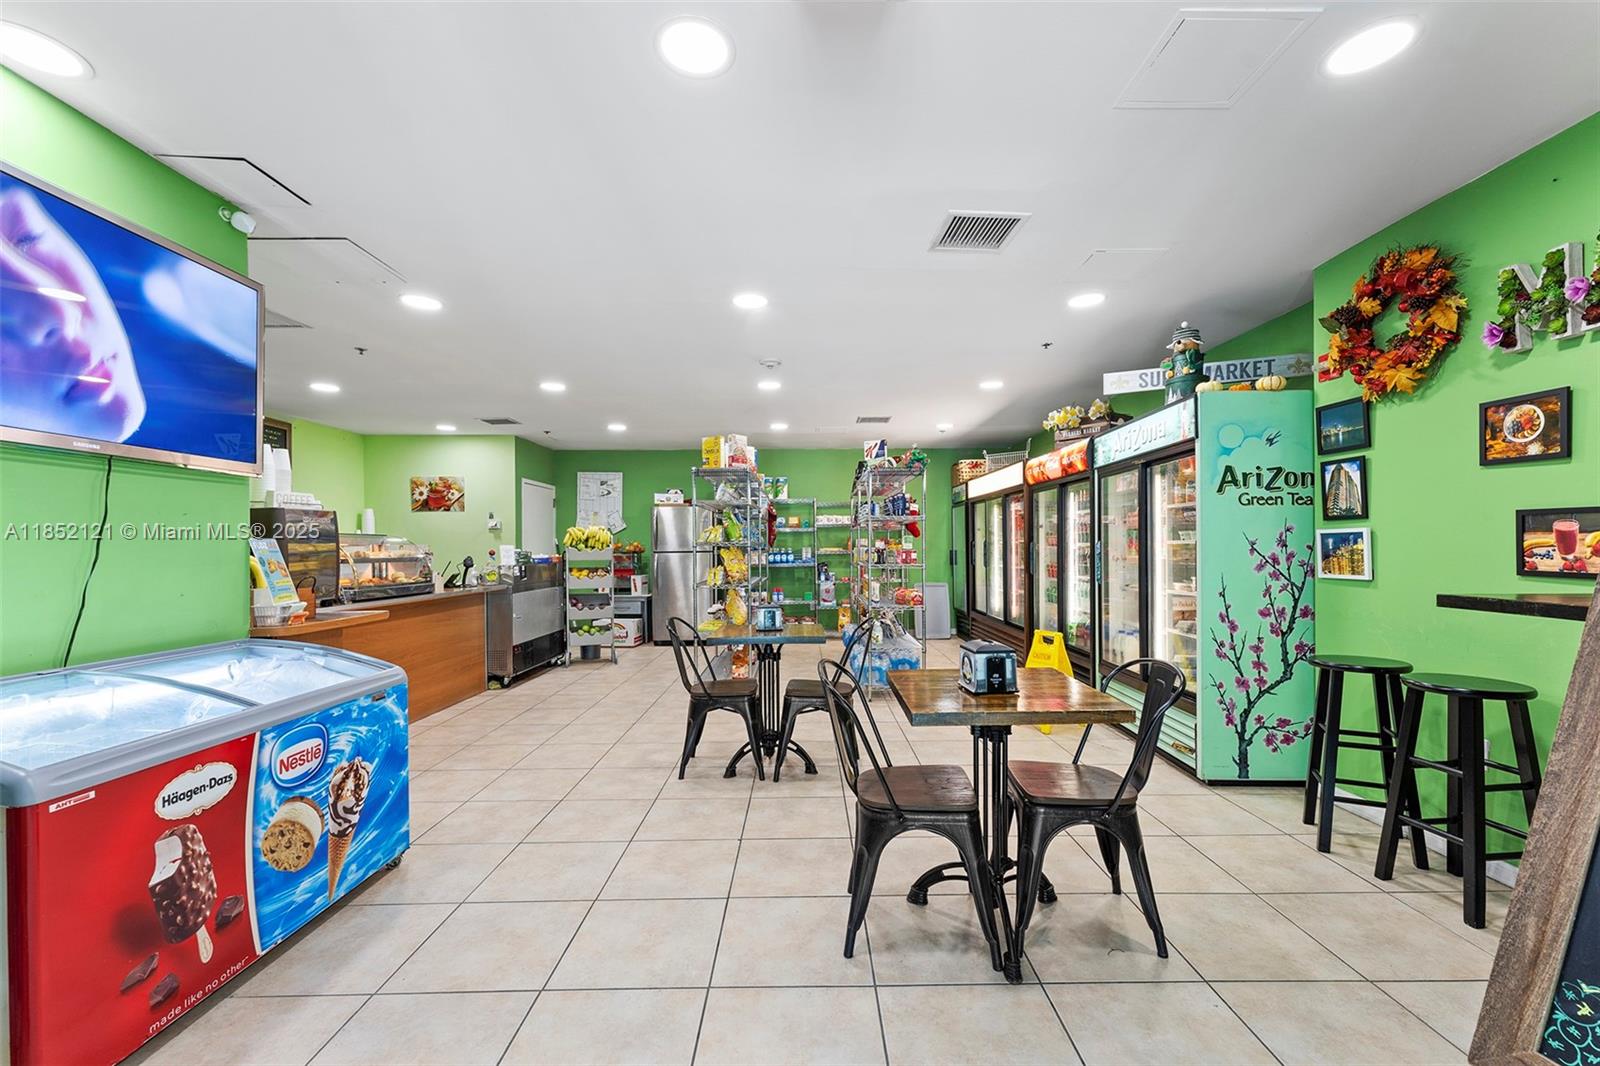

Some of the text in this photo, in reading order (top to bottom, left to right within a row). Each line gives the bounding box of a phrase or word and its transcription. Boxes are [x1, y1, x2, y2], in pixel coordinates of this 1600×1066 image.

[1238, 492, 1314, 506] Green Tea
[149, 1006, 182, 1034] made
[184, 990, 203, 1008] like
[205, 979, 219, 993] no
